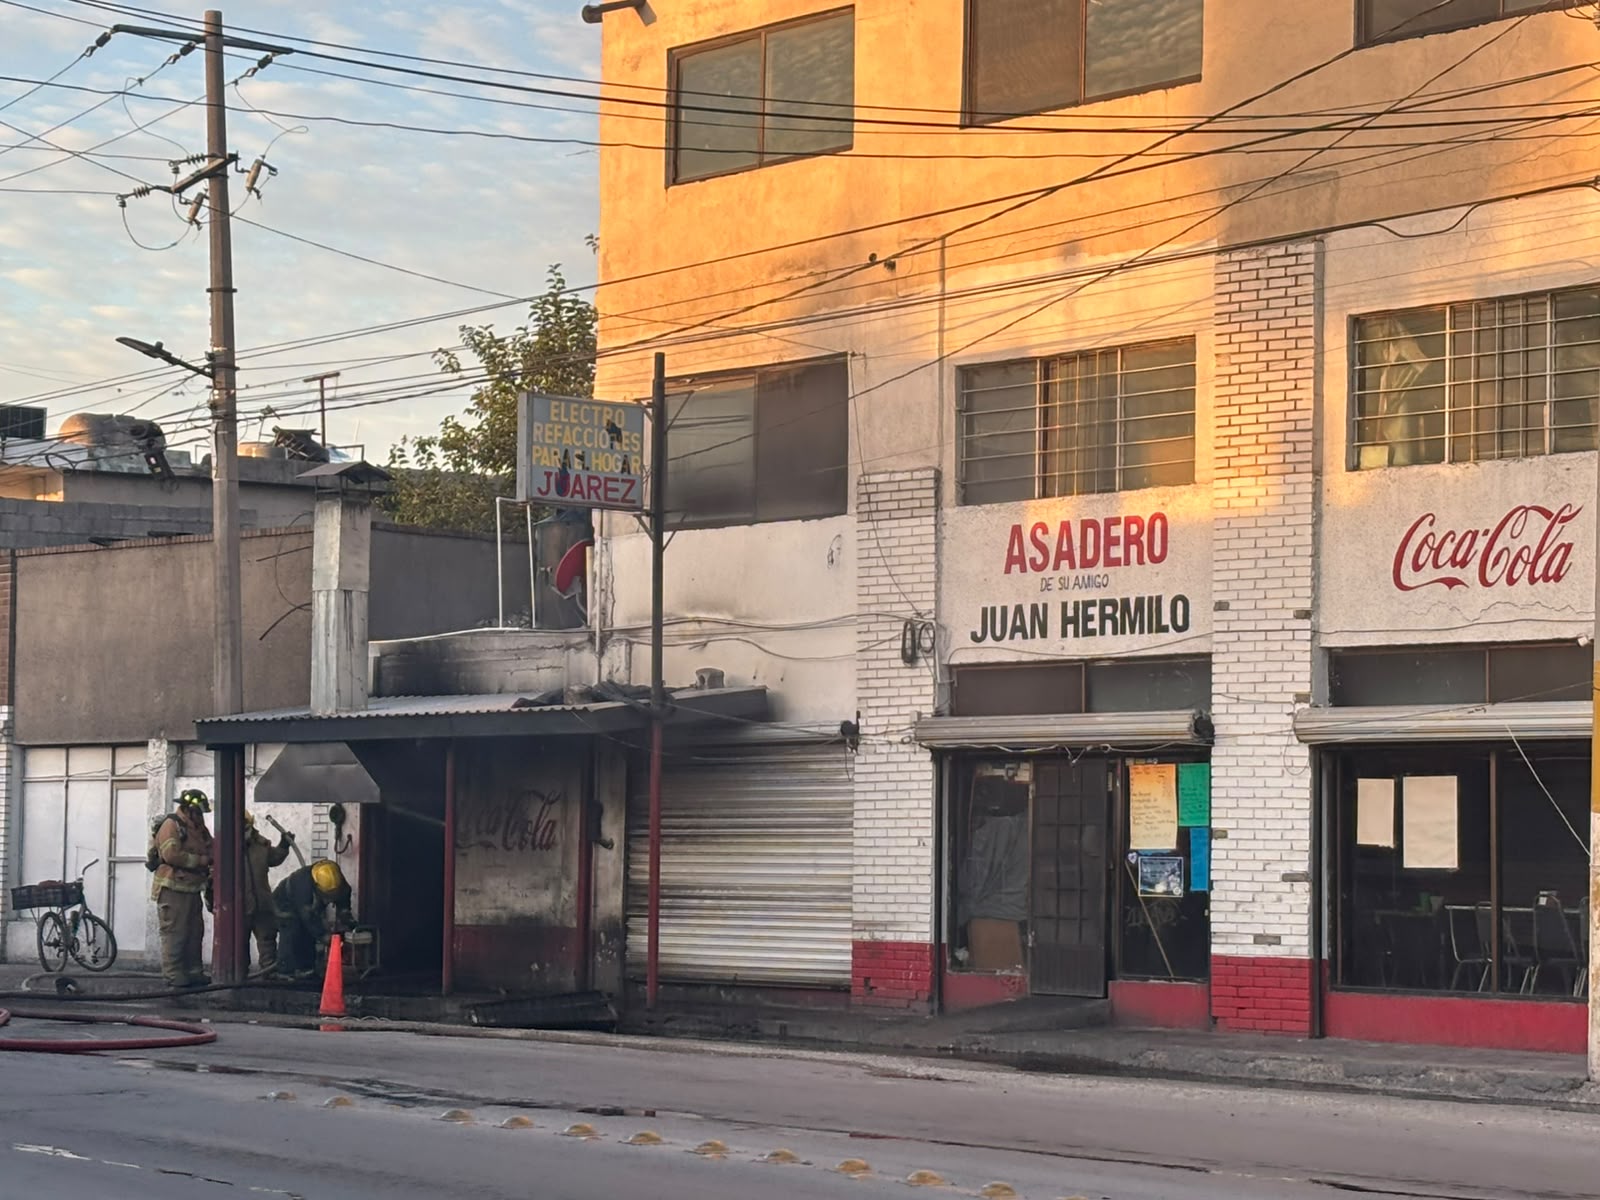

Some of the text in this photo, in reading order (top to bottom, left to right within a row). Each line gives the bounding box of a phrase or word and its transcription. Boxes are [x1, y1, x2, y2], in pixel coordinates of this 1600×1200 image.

[550, 400, 625, 428] ELECTRO
[532, 446, 572, 469] PARA
[591, 452, 641, 475] HOGAR
[538, 472, 636, 503] JUAREZ
[1003, 511, 1169, 575] ASADERO
[1040, 573, 1110, 592] DE SU AMIGO
[970, 594, 1190, 643] JUAN HERMILO
